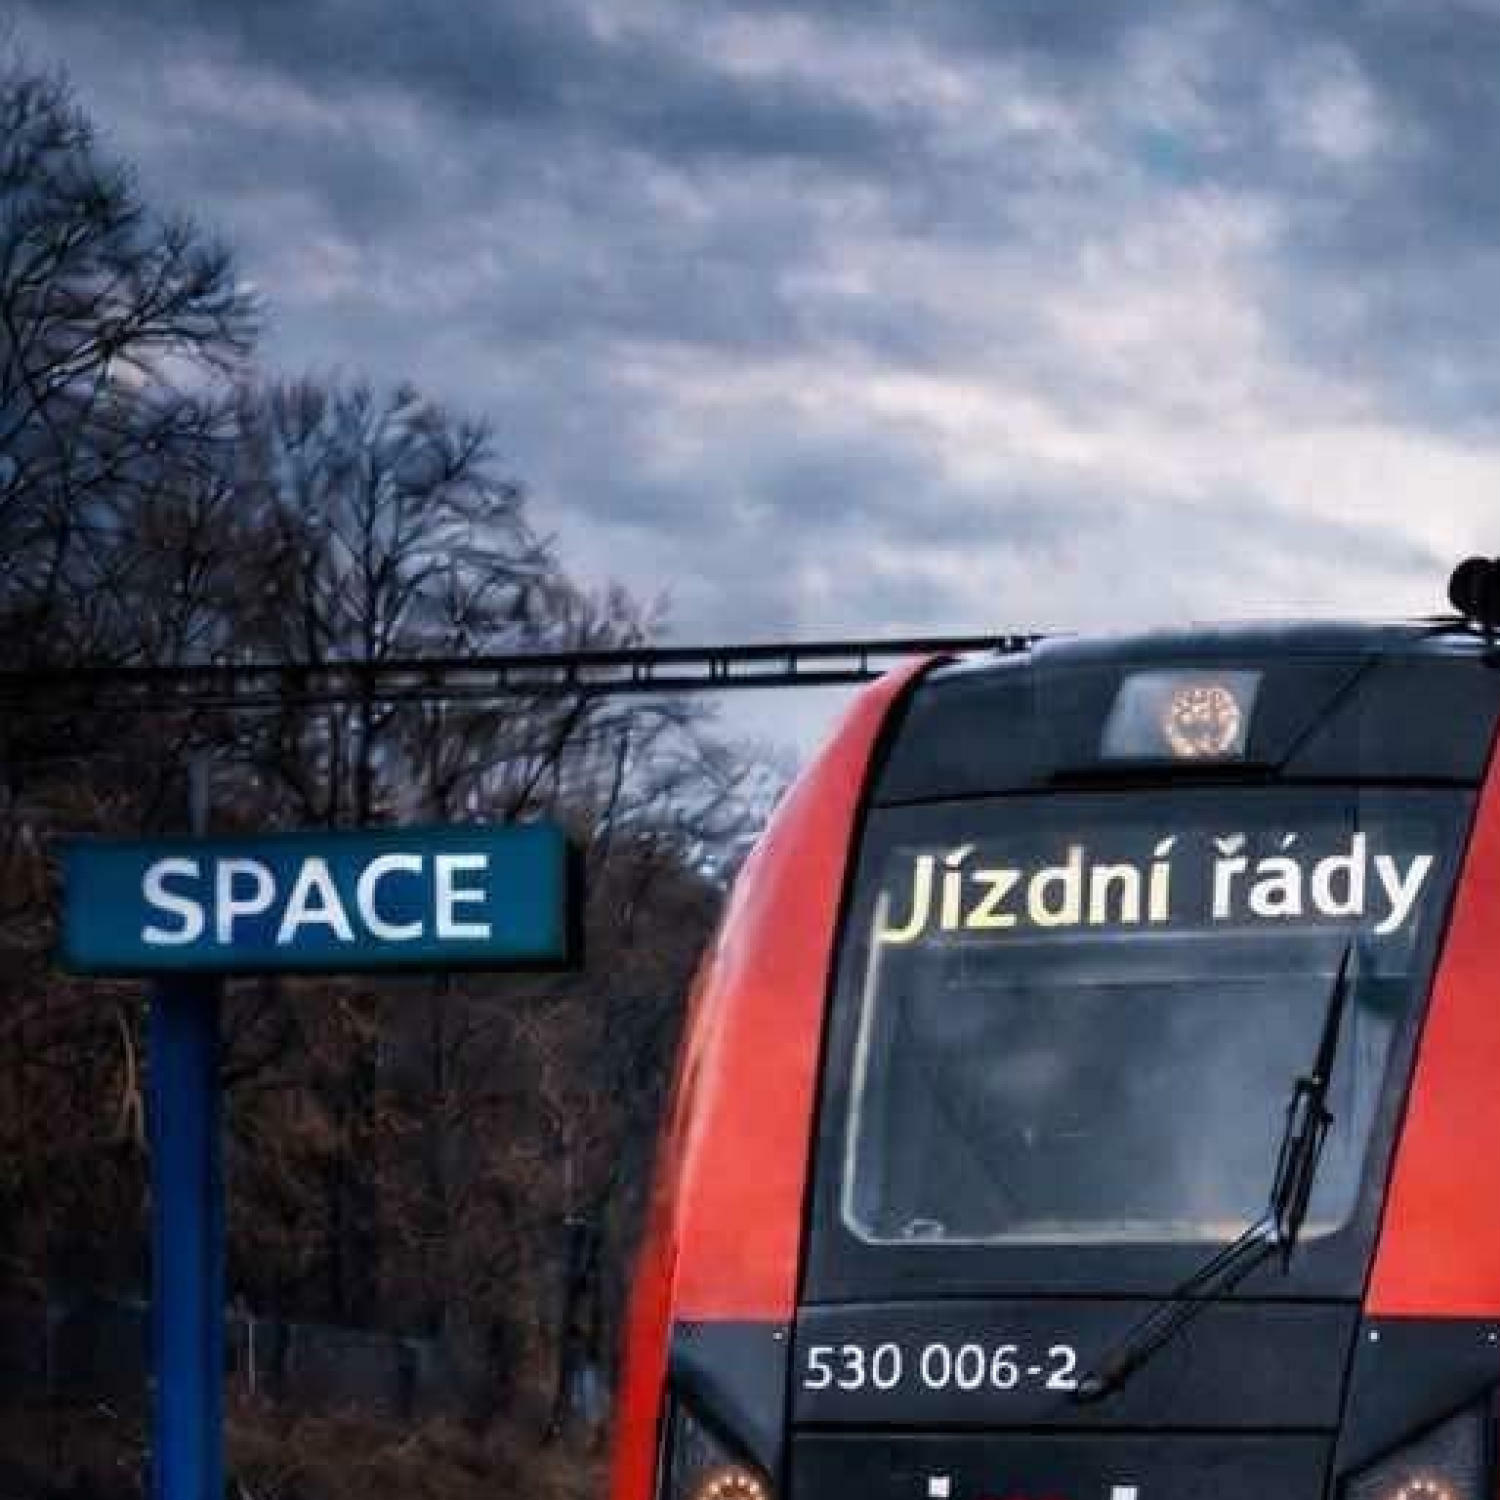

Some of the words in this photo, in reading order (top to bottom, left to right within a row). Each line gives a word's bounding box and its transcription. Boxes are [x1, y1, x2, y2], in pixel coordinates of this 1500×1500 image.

[140, 853, 492, 946] SPACE
[876, 833, 1177, 942] Jízdní
[1212, 831, 1434, 935] řády
[803, 1344, 901, 1390] 530
[921, 1343, 1078, 1390] 006-2
